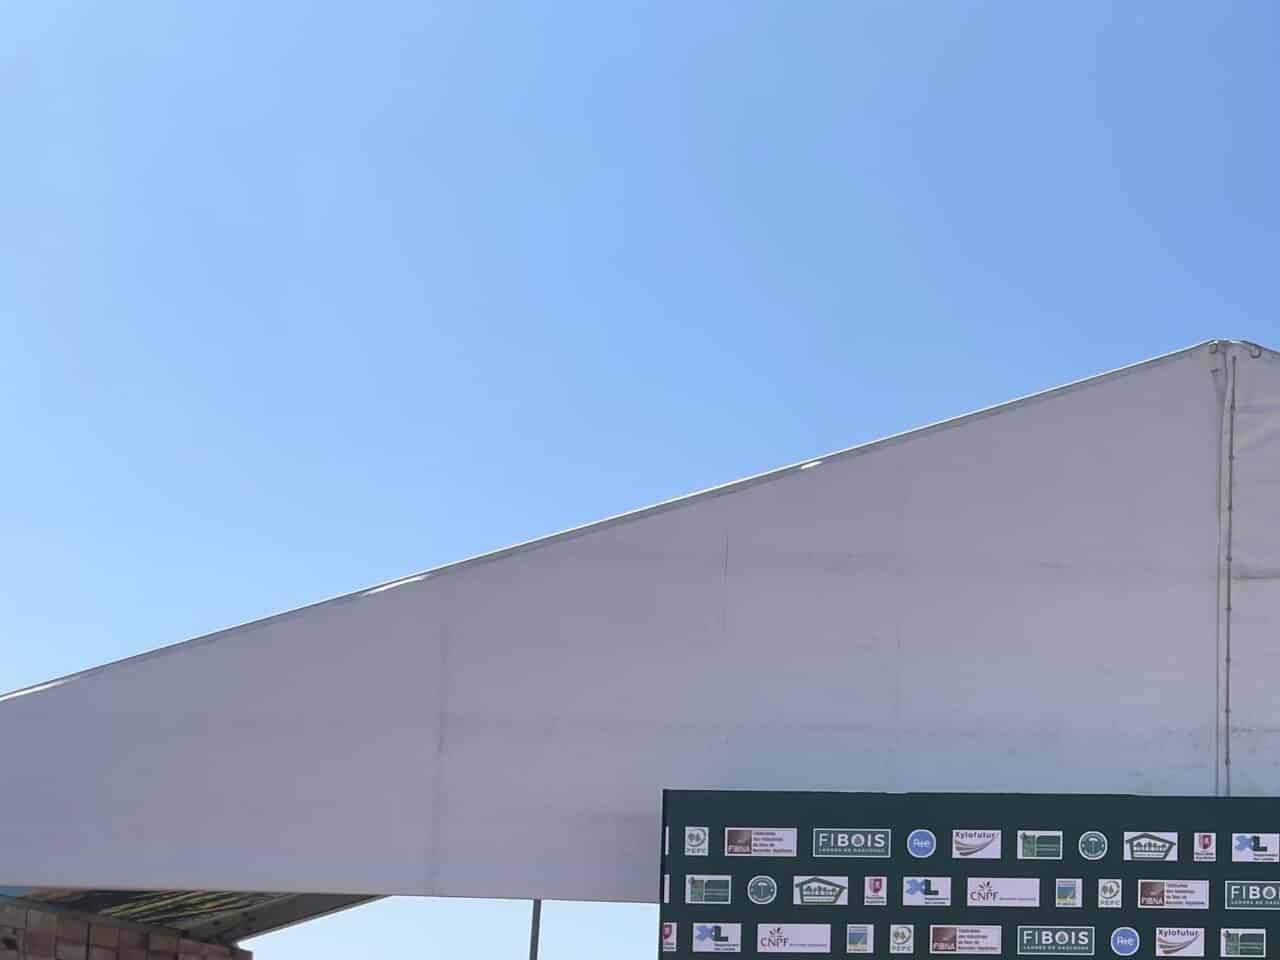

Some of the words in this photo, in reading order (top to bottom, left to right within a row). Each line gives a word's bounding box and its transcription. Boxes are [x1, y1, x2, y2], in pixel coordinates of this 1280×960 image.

[819, 833, 885, 847] FIBOIS
[970, 891, 999, 900] CNPF
[1158, 929, 1198, 937] Xylofutur
[760, 937, 789, 946] CNPF
[1023, 931, 1089, 945] FIBOIS
